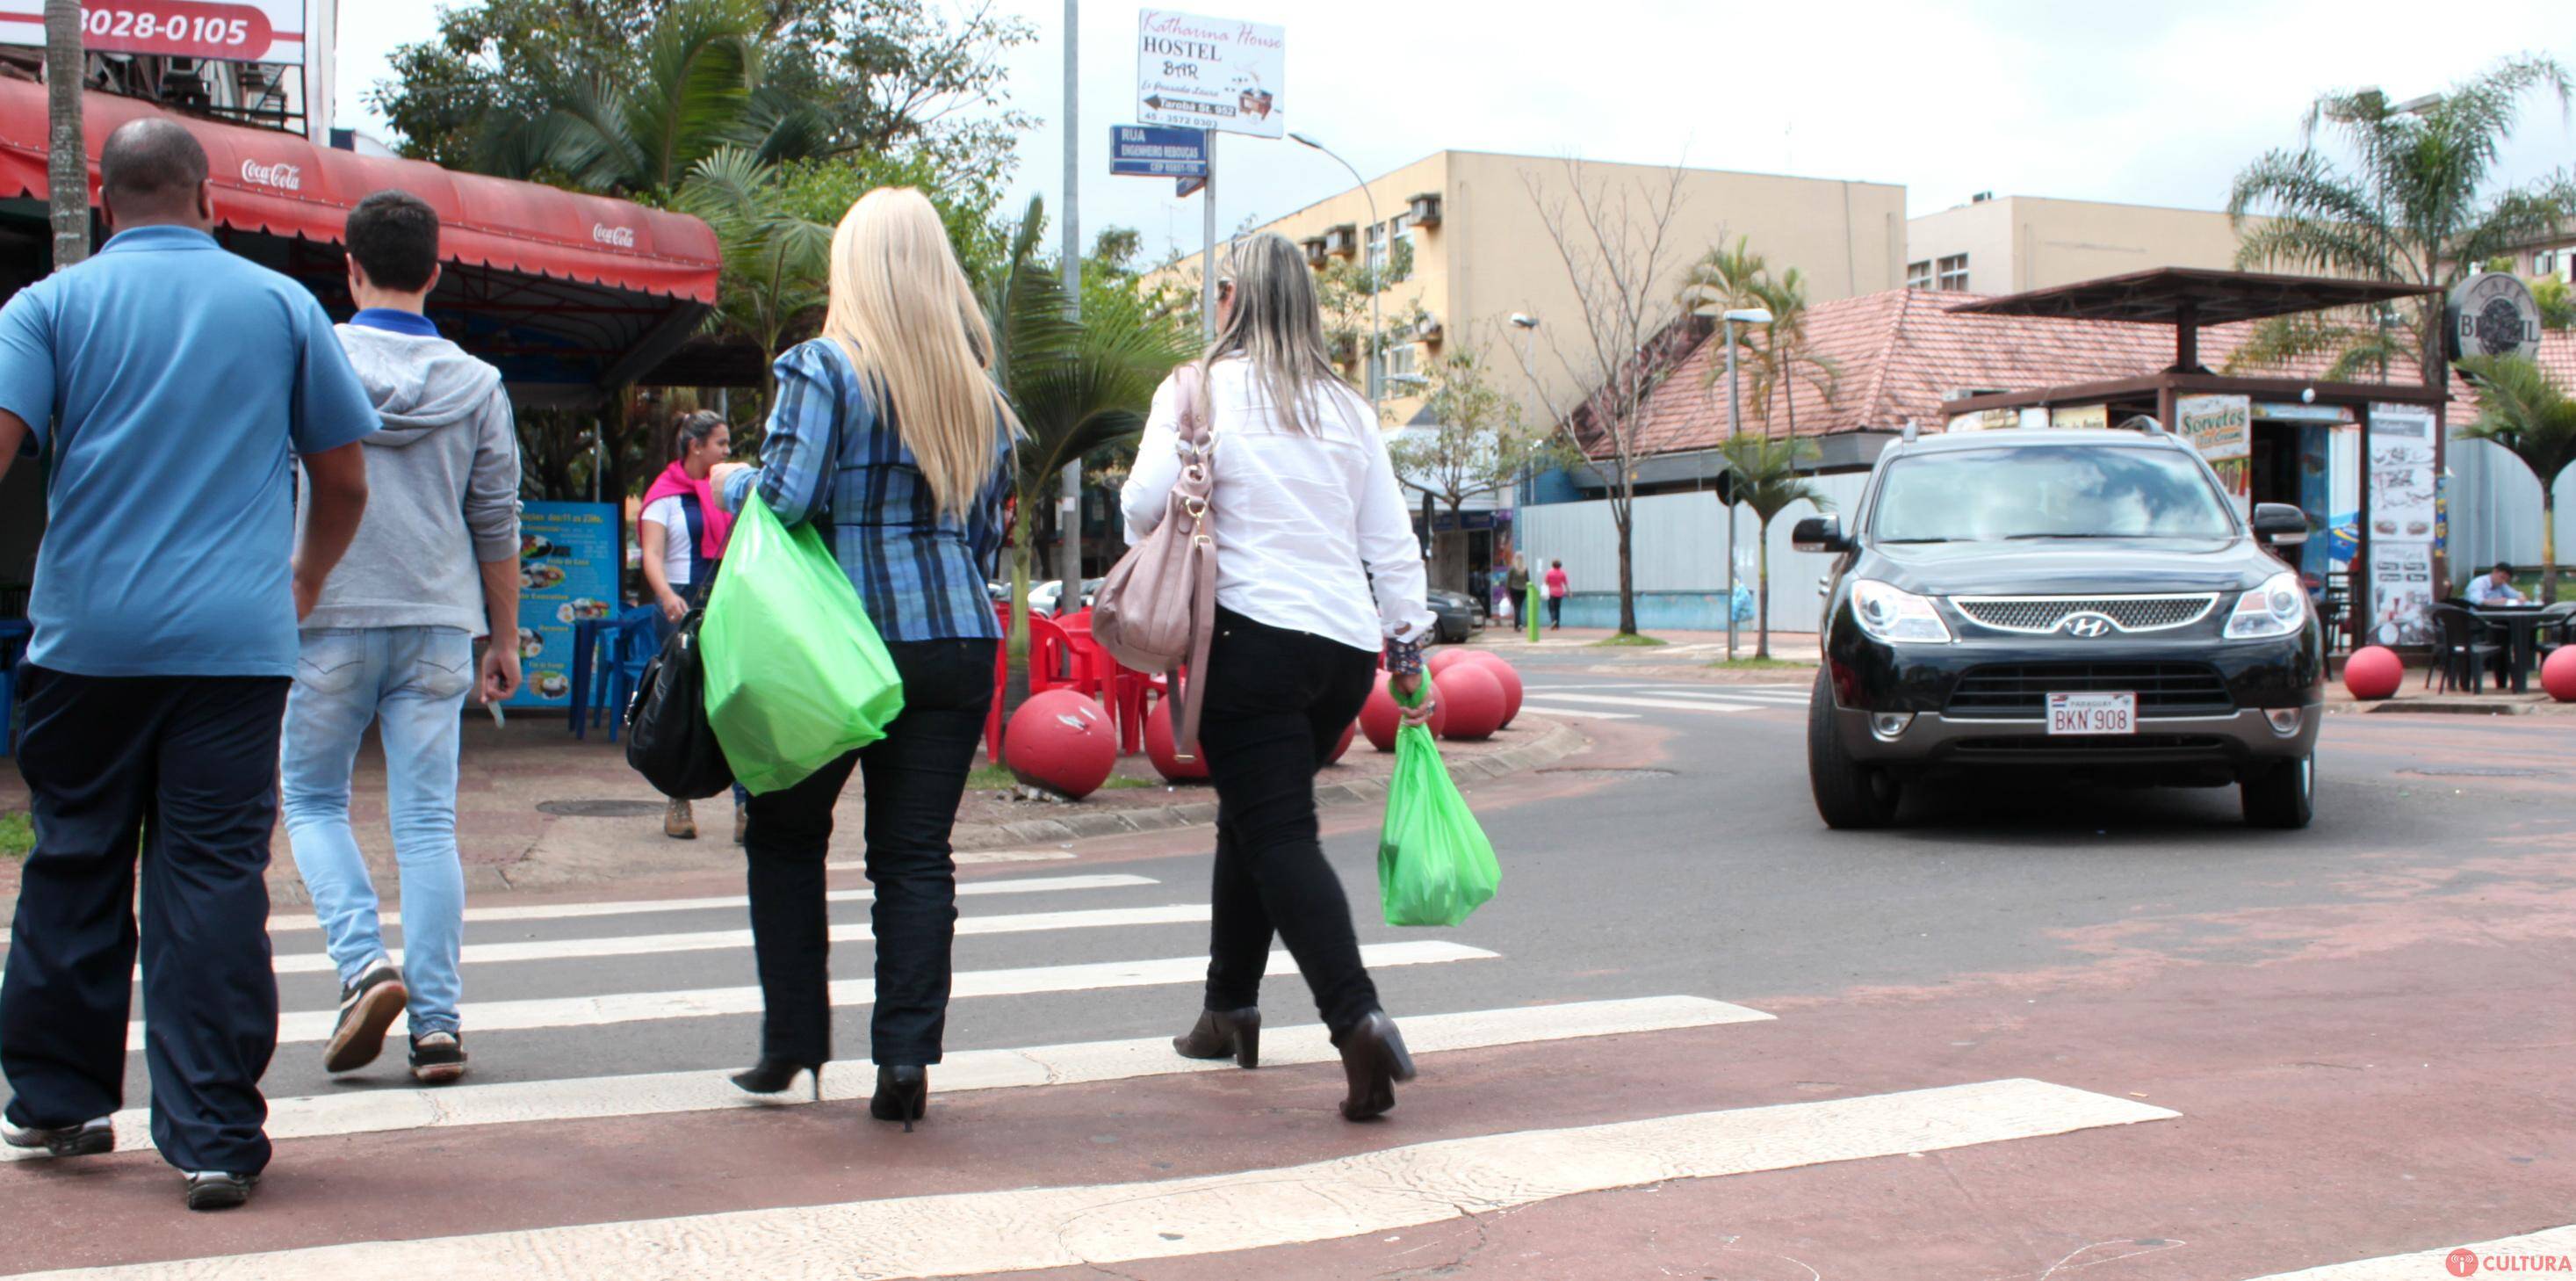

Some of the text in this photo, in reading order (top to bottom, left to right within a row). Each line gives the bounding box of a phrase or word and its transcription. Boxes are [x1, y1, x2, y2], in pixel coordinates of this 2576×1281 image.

[1144, 11, 1281, 48] Katharina House
[1144, 36, 1222, 62] HOSTEL
[1163, 61, 1199, 79] BAR
[1145, 112, 1157, 120] 45
[1122, 127, 1145, 142] RUA
[1122, 143, 1163, 157] ENGENHEIRO
[2181, 406, 2245, 437] Sorvetes
[2055, 709, 2127, 731] BKN 908
